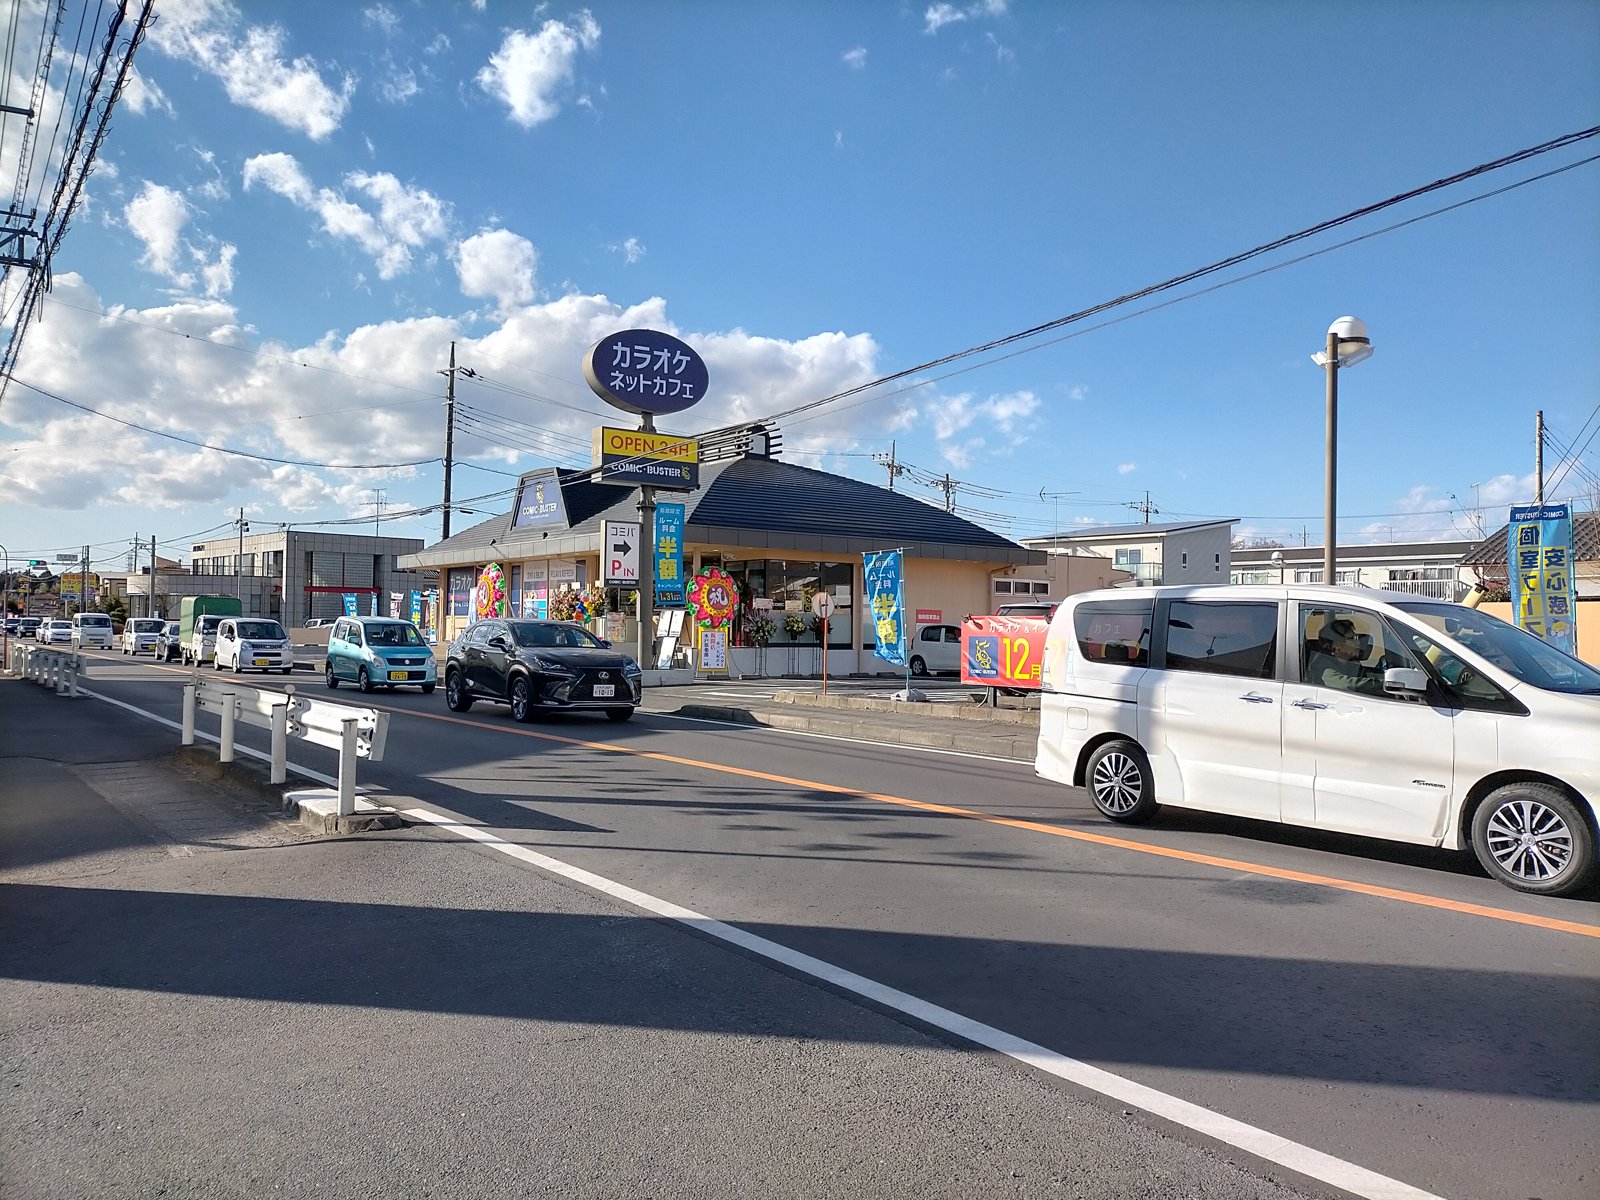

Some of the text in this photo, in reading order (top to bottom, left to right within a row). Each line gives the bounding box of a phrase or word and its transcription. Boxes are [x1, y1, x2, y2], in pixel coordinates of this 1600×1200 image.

[612, 341, 691, 375] カラオケ
[610, 370, 694, 399] ネットカフェ
[610, 435, 689, 456] OPEN 24H
[659, 517, 679, 525] ルーム
[611, 560, 635, 576] P IN
[450, 575, 472, 590] カラオケ
[989, 621, 1021, 633] カラオケ
